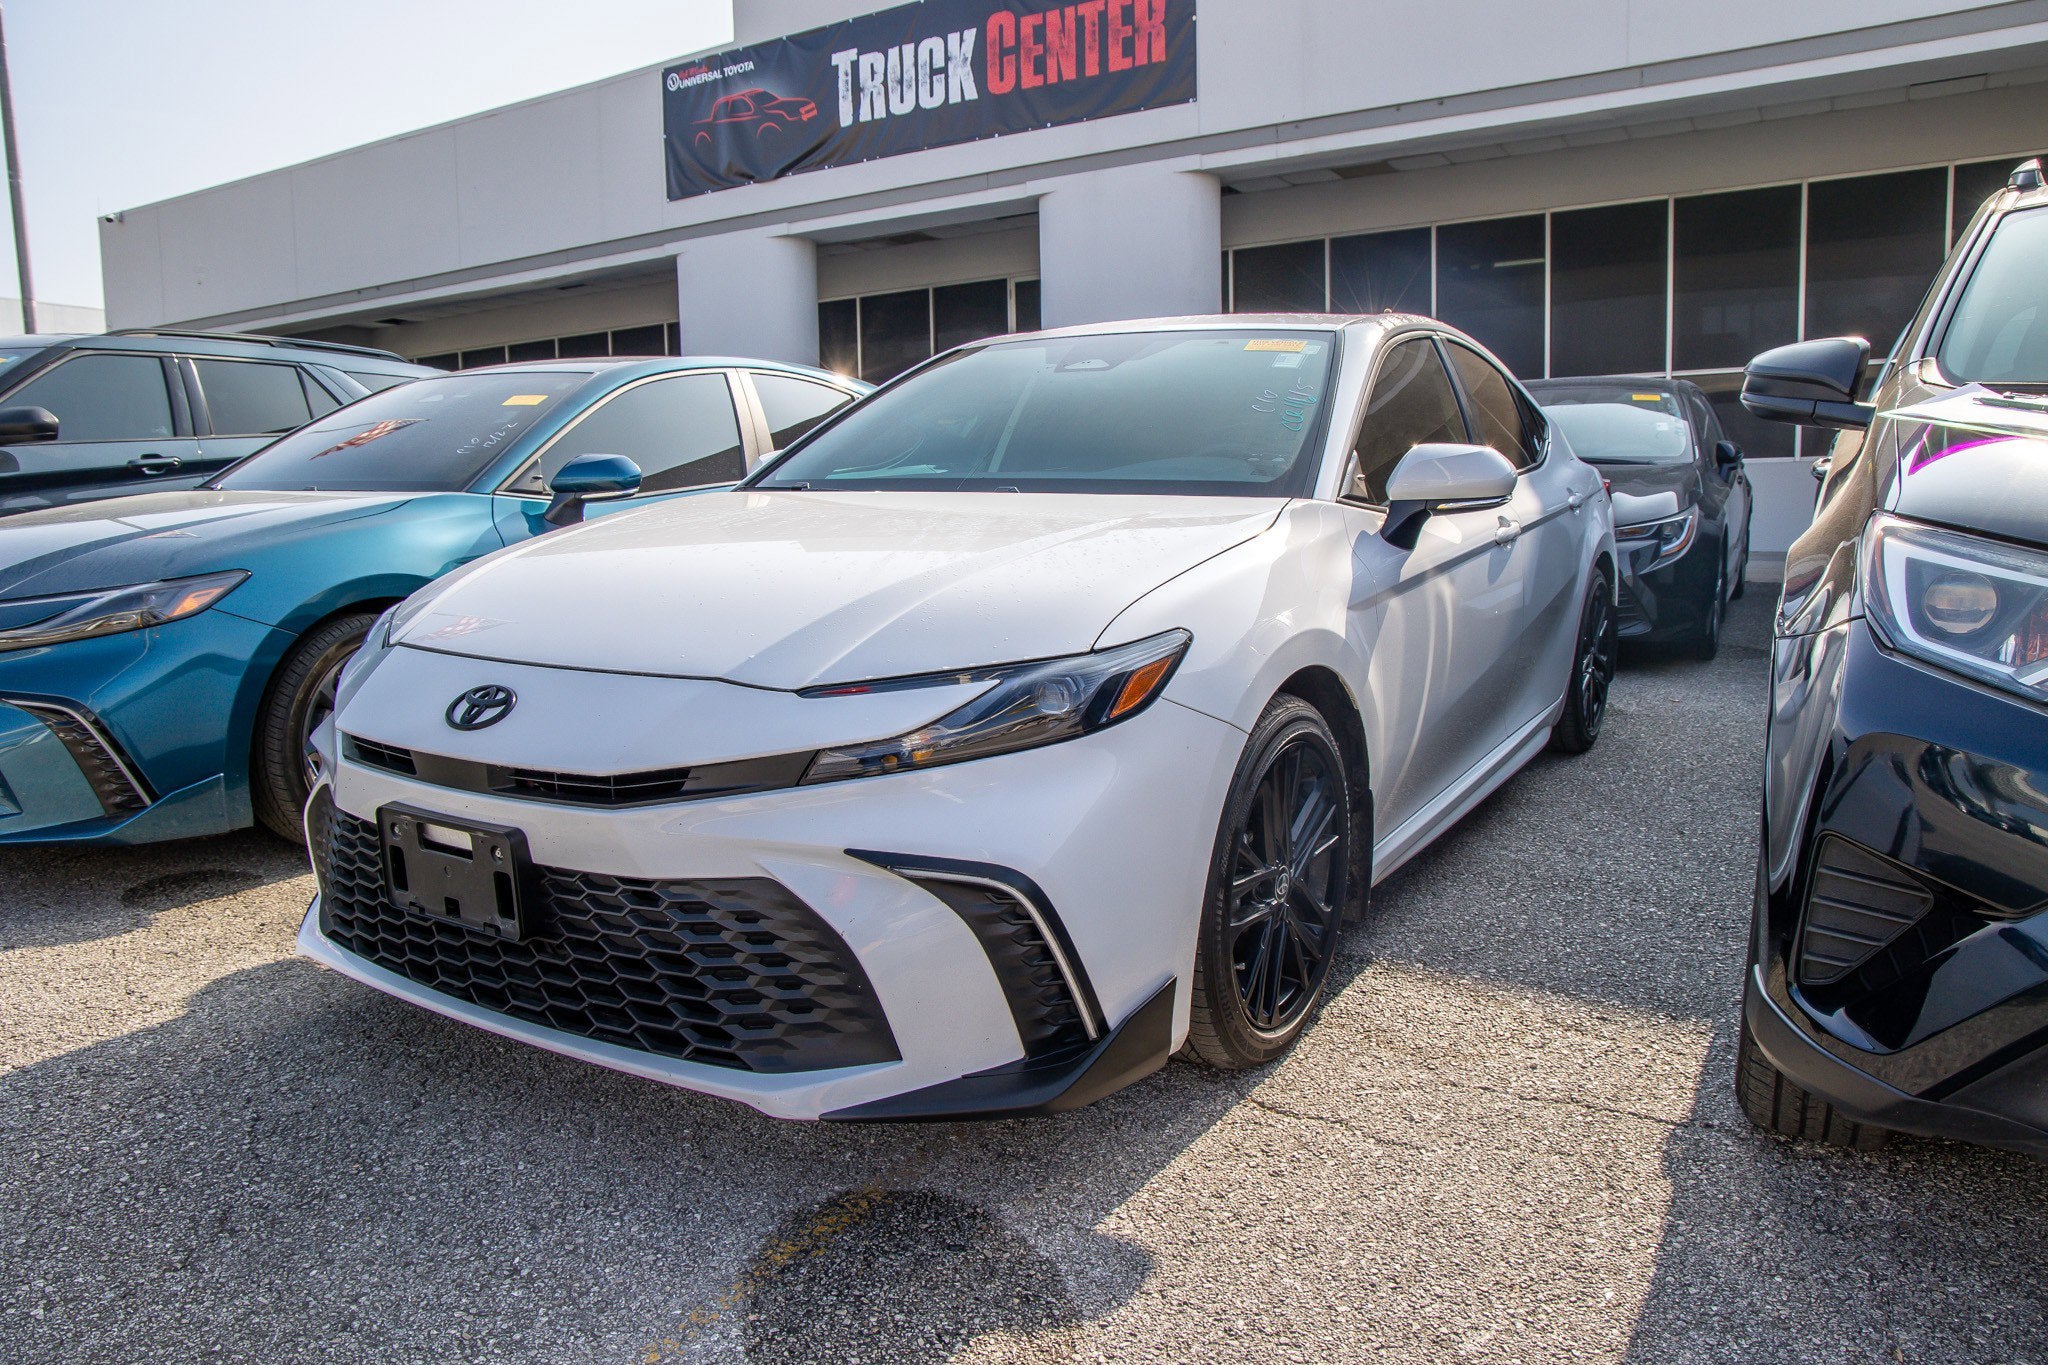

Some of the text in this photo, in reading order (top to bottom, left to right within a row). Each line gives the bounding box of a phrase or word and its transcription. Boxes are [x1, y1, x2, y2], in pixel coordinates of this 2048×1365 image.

[679, 69, 722, 89] UNIVERSAL
[723, 61, 754, 77] TOYOTA
[831, 0, 1166, 127] TRUCK CENTER
